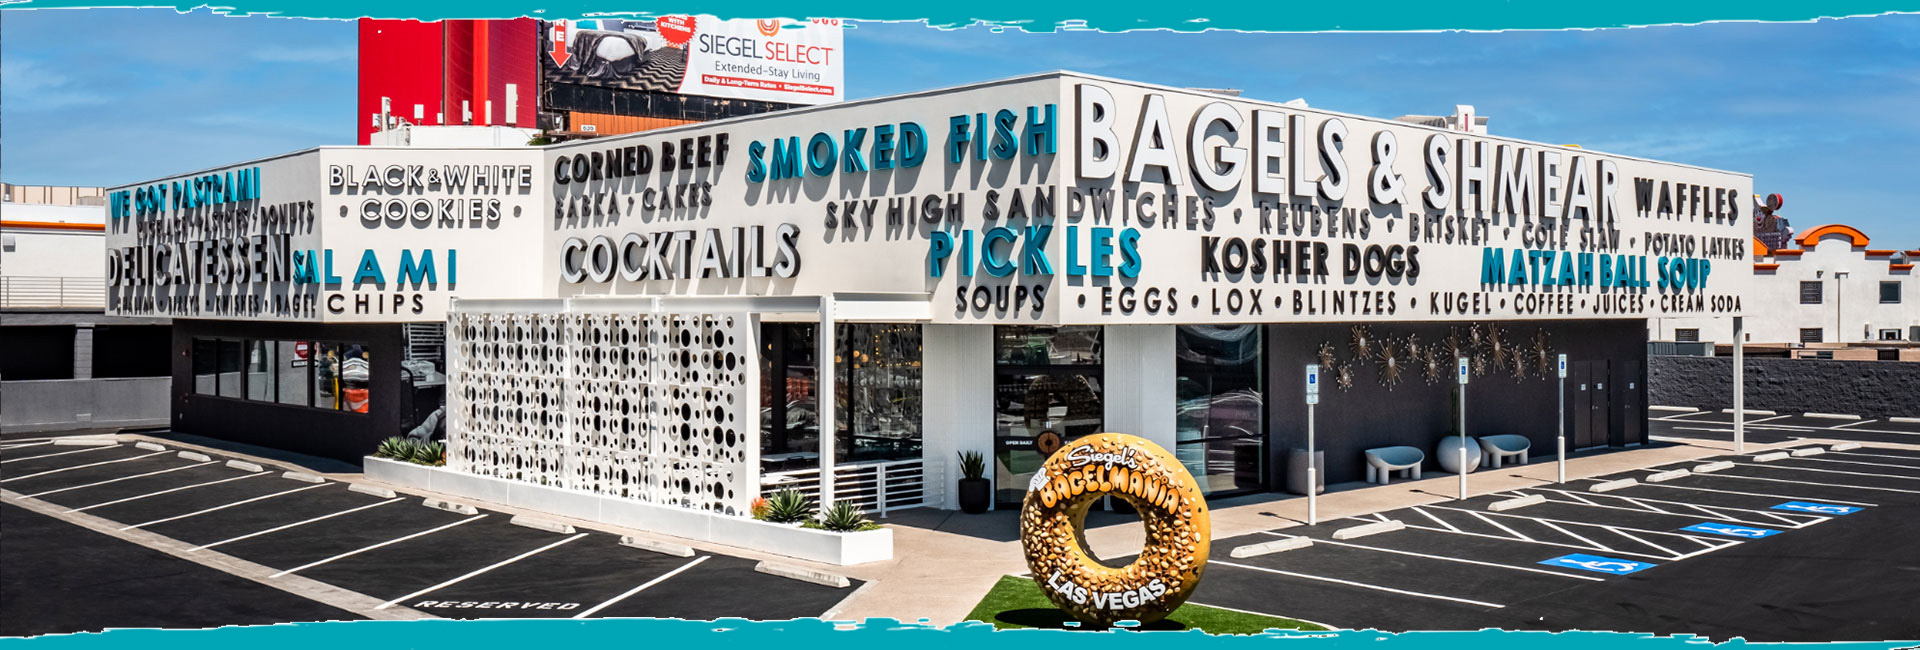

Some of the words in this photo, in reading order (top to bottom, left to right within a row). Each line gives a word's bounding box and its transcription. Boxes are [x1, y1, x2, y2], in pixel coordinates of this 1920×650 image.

[660, 21, 691, 32] KITCHENS
[699, 33, 763, 59] SIEGEL
[765, 41, 833, 66] SELECT
[704, 76, 720, 86] Daily
[726, 78, 759, 90] Long-Term
[760, 81, 777, 89] Rates
[783, 82, 833, 94] SiegelSelect.com
[715, 61, 789, 80] Extended-Stay
[792, 68, 821, 82] Living
[554, 145, 654, 185] CORNED
[661, 132, 730, 173] BEEF
[747, 121, 928, 184] SMOKED
[949, 103, 1058, 164] FISH
[1074, 83, 1350, 201] BAGELS
[1367, 129, 1409, 205] &
[1421, 133, 1621, 225] SHMEAR
[110, 190, 130, 218] WE
[135, 183, 168, 215] GOT
[172, 167, 260, 211] PASTRAMI
[360, 199, 501, 222] COOKIES
[554, 191, 621, 219] BABKA
[642, 181, 713, 212] CAKES
[983, 184, 1216, 226] SANDWICHES
[1634, 176, 1739, 221] WAFFLES
[260, 200, 314, 226] DONUTS
[1259, 200, 1371, 237] REUBENS
[1409, 212, 1490, 243] BRISKET
[560, 223, 802, 284] COCKTAILS
[930, 224, 1142, 279] PICKLES
[1521, 221, 1569, 248] COLE
[1579, 226, 1621, 251] SLAW
[1644, 231, 1696, 256] POTATO
[1701, 235, 1745, 260] LATKES
[107, 233, 291, 287] DELICATESSEN
[293, 249, 457, 286] SALAMI
[1201, 236, 1329, 276] KOSHER
[1342, 243, 1421, 278] DOGS
[1481, 246, 1594, 287] MATZAH
[1600, 253, 1651, 288] BALL
[1657, 255, 1711, 290] SOUP
[215, 294, 260, 314] KNISHES
[275, 293, 317, 313] BAGEL
[327, 294, 423, 314] CHIPS
[955, 284, 1045, 313] SOUPS
[1101, 286, 1178, 313] EGGS
[1211, 288, 1263, 315] LOX
[1292, 289, 1397, 315] BLINTZES
[1430, 291, 1492, 314] KUGEL
[1513, 292, 1574, 314] COFFEE
[1592, 294, 1644, 314] JUICES
[1660, 294, 1705, 313] CREAM
[1710, 295, 1742, 313] SODA
[1066, 445, 1138, 472] Siegel's
[413, 600, 581, 611] RESERVED
[1047, 570, 1088, 606] LAS
[1090, 577, 1167, 611] VEGAS
